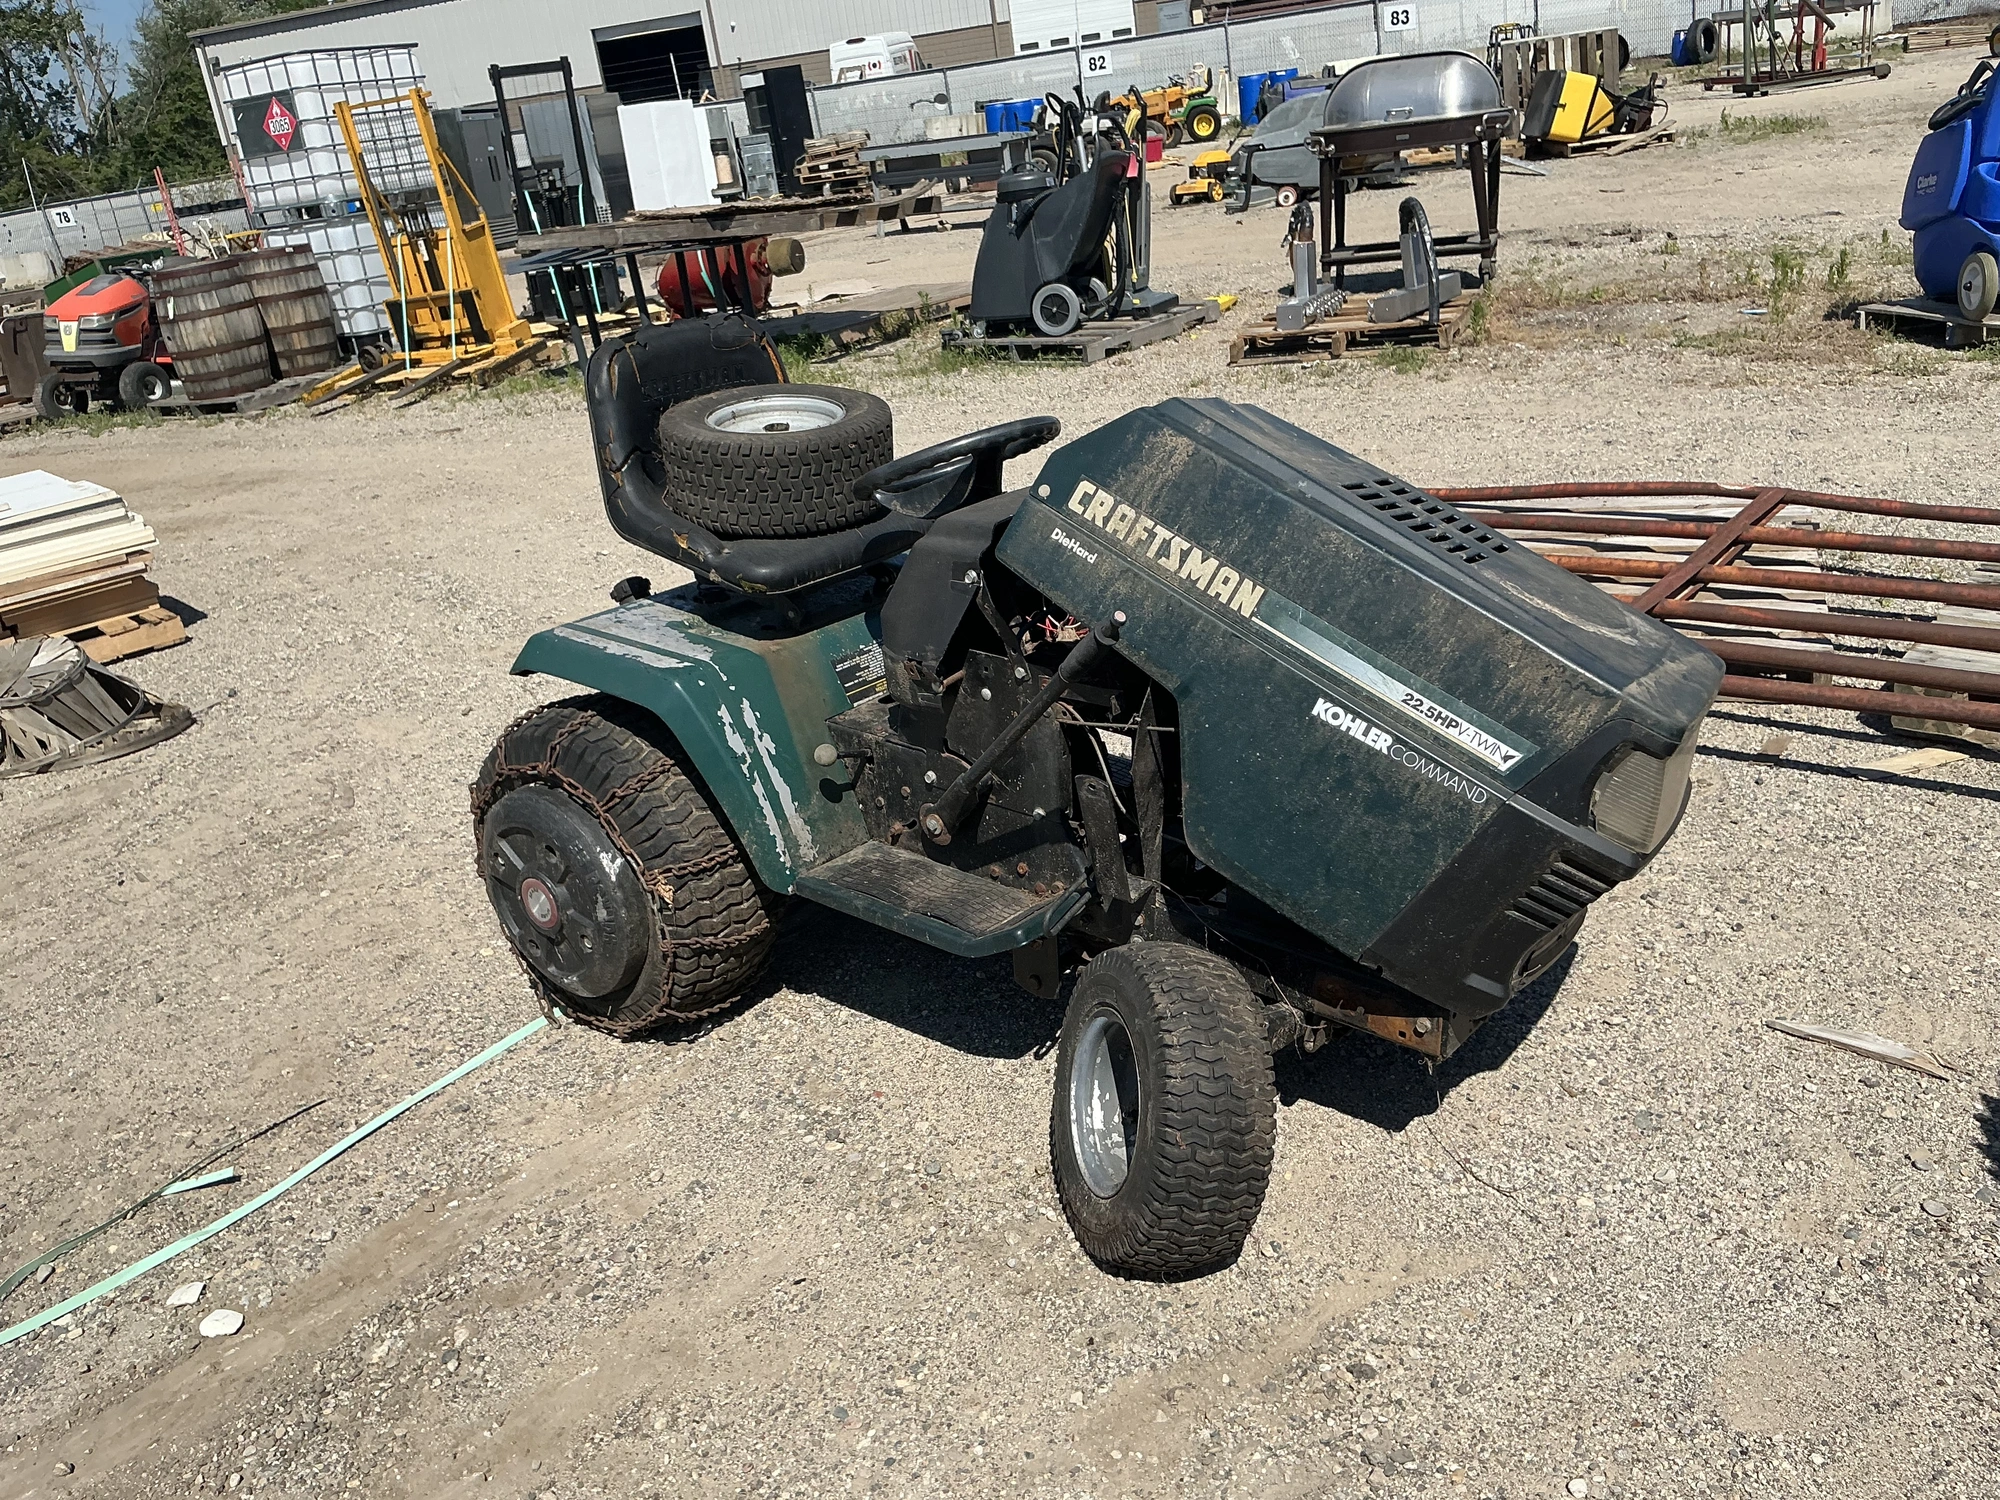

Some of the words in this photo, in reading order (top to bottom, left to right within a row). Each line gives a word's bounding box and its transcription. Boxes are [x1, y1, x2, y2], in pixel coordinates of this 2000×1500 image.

[1390, 9, 1410, 26] 83
[1088, 55, 1107, 72] 82
[270, 117, 291, 134] 3065
[280, 137, 286, 146] 3
[1917, 173, 1938, 190] Clarke
[55, 211, 71, 224] 78
[1050, 527, 1098, 564] DieHard
[1067, 479, 1266, 619] CRAFTSMAN
[1311, 697, 1393, 754] KOHLER
[1390, 744, 1487, 804] COMMAND
